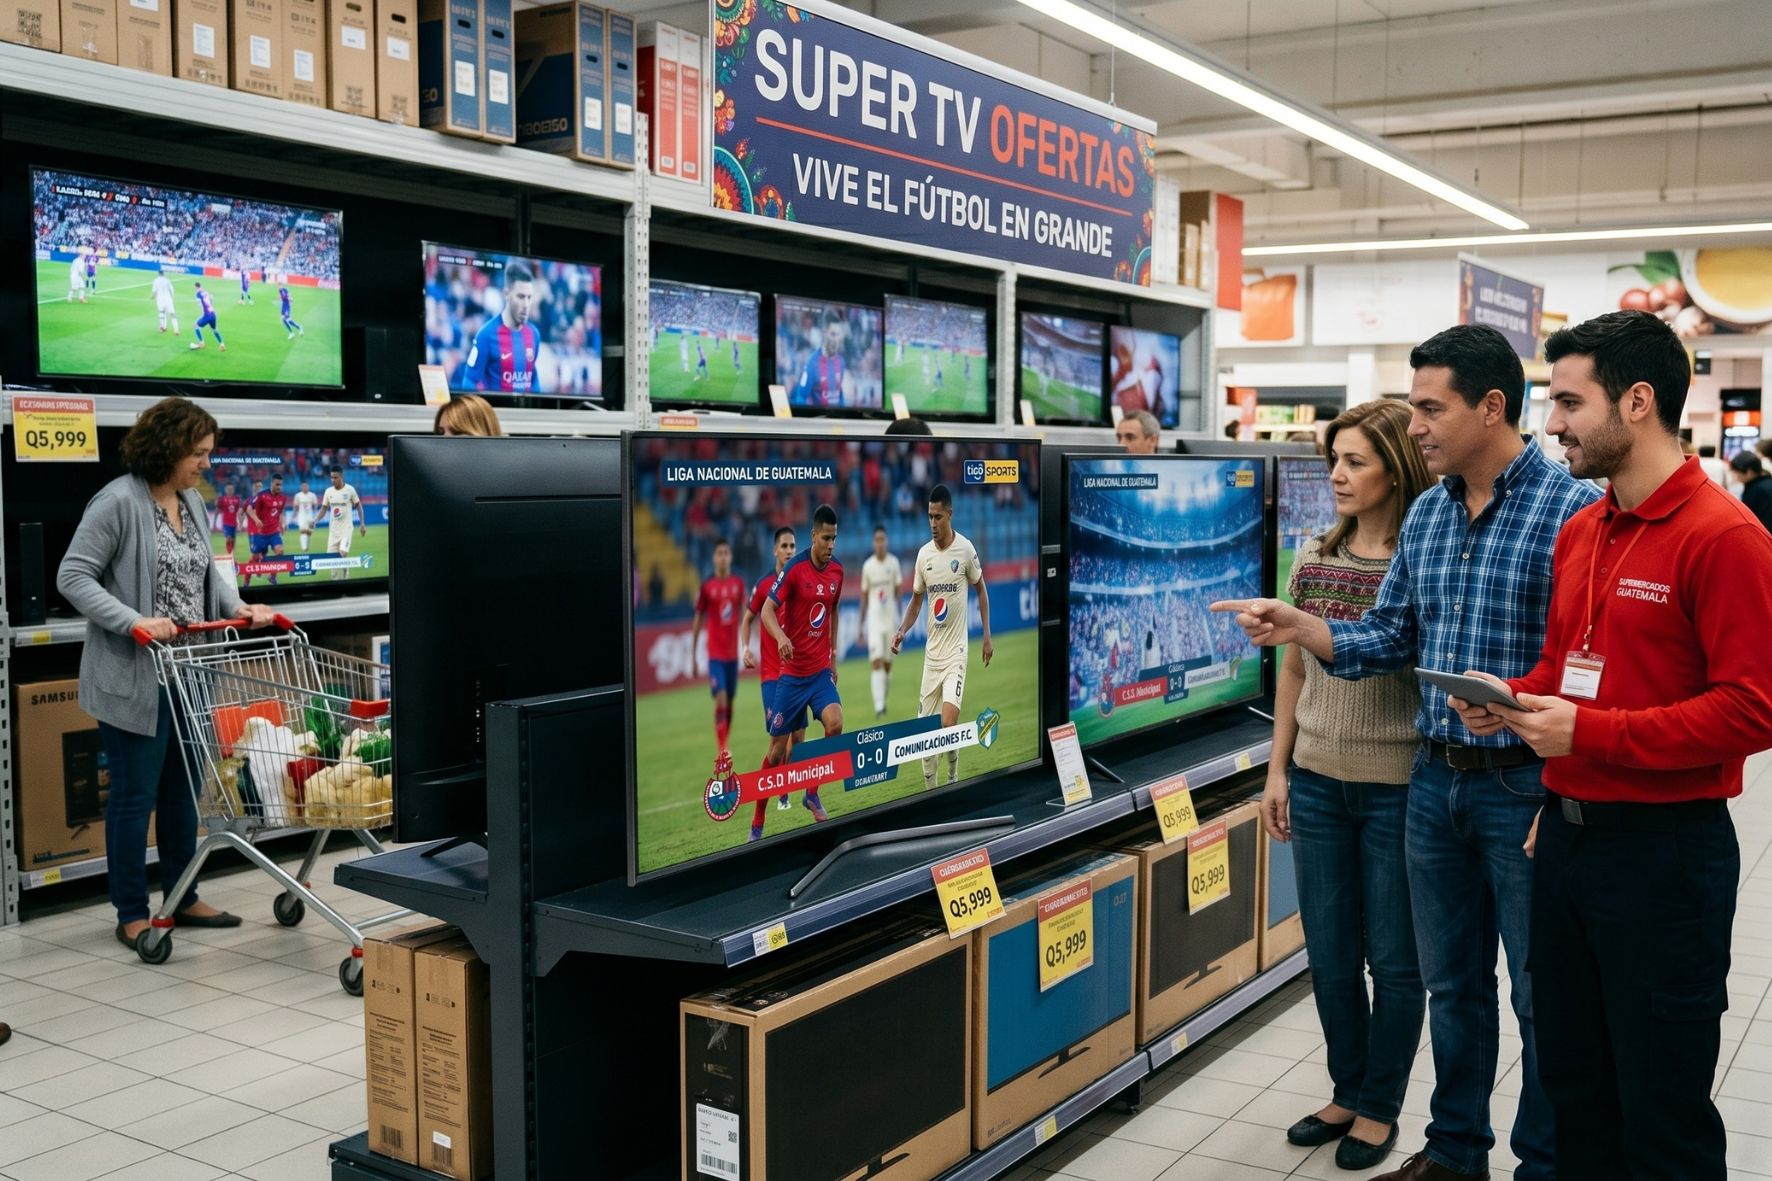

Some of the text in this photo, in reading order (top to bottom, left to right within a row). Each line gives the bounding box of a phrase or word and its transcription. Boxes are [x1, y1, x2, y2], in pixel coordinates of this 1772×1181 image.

[755, 28, 917, 139] SUPER
[928, 81, 982, 154] TV
[991, 104, 1135, 198] OFERTAS
[793, 153, 1112, 257] VIVE EL FÚTBOL EN GRANDE
[26, 430, 86, 450] Q5,999
[667, 466, 832, 481] LIGA NACIONAL DE GUATEMALA
[986, 466, 1016, 476] SPORTS
[1616, 587, 1668, 604] GUATEMALA
[31, 690, 78, 706] SAMSU
[856, 729, 884, 745] Clásico
[787, 760, 835, 785] Municipal
[1163, 805, 1192, 828] Q5,999
[1192, 864, 1225, 895] Q5,999
[950, 886, 992, 918] Q5,999
[1045, 929, 1087, 968] Q5,999
